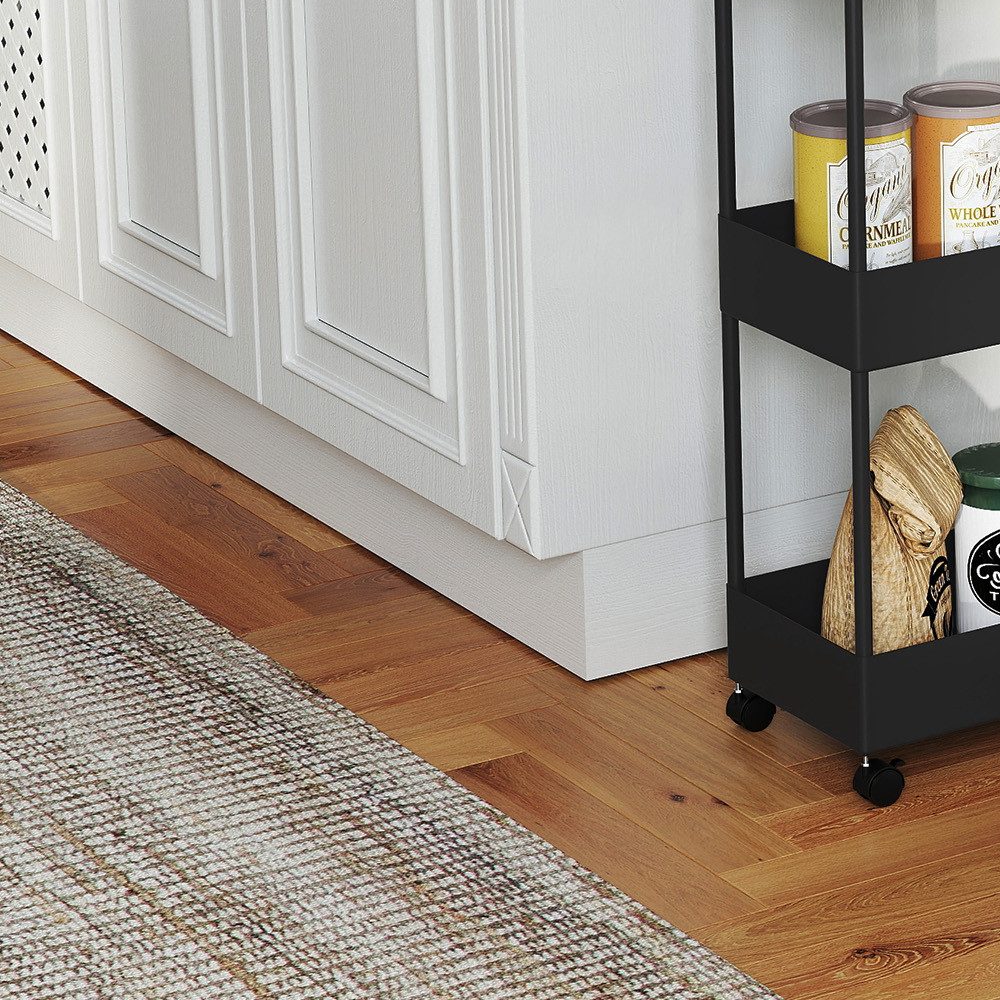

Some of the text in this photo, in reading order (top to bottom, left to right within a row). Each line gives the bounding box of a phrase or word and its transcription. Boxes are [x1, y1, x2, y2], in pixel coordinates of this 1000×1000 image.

[949, 204, 996, 221] WHOLE
[840, 216, 911, 242] CRNMEAL
[987, 219, 999, 227] AND
[874, 240, 887, 248] AND
